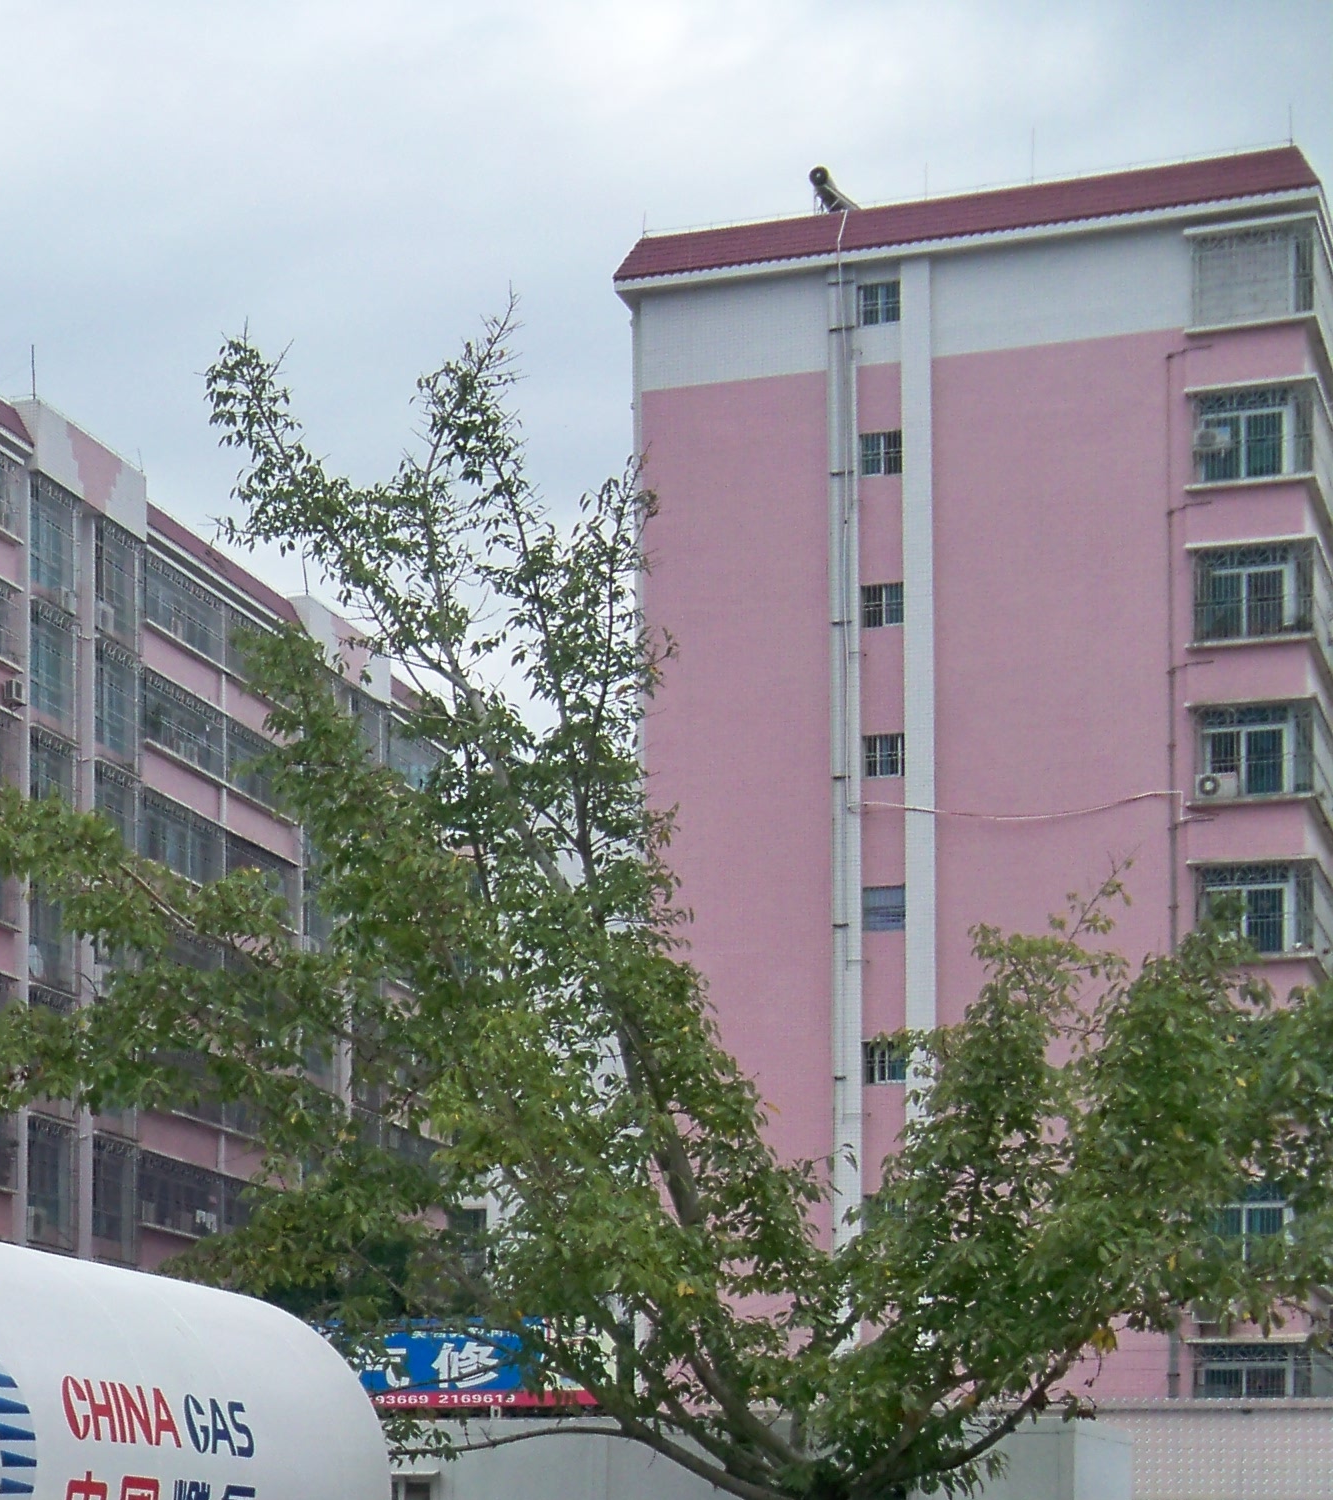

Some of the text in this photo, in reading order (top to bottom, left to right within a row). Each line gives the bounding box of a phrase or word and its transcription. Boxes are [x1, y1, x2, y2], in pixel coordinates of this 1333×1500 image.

[61, 1375, 255, 1458] CHINA GAS
[369, 1394, 429, 1405] 93669
